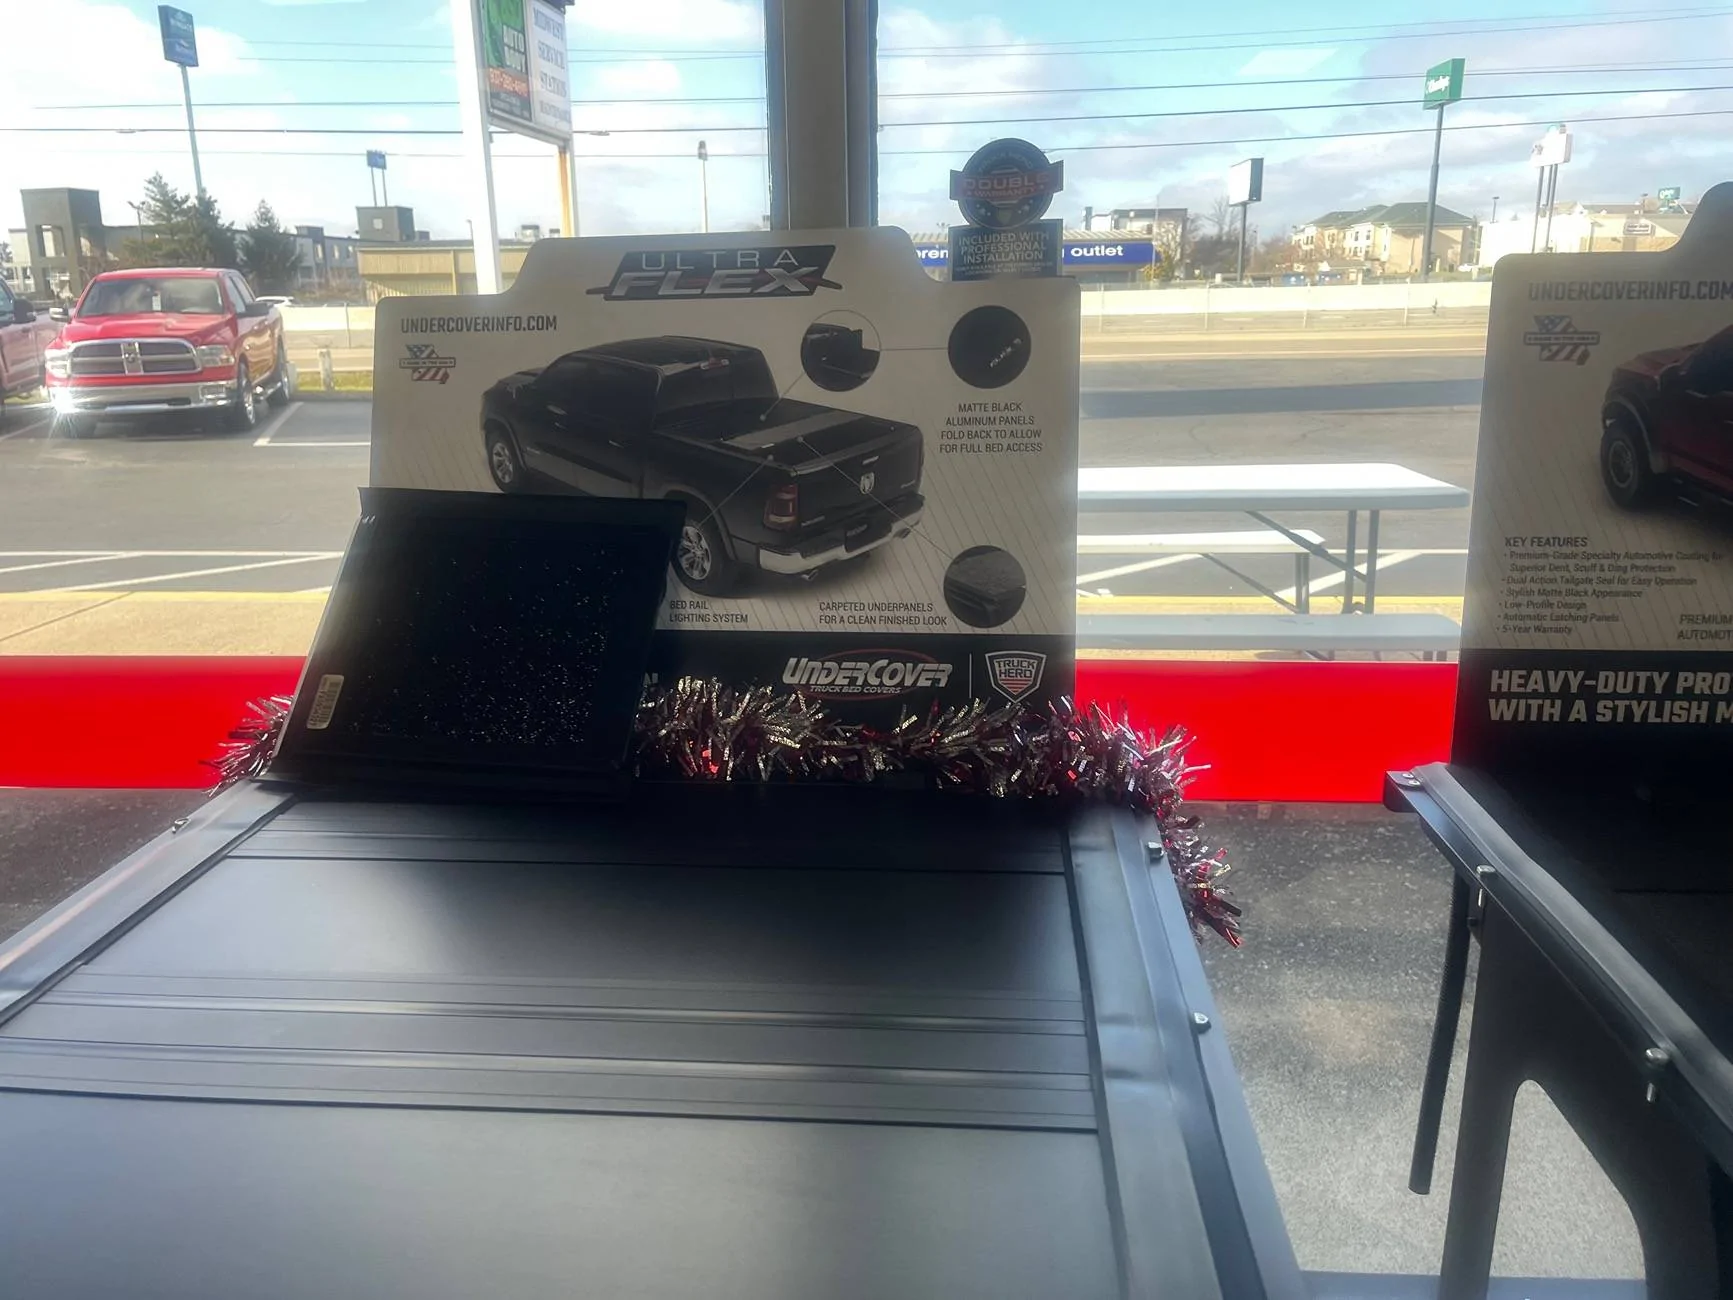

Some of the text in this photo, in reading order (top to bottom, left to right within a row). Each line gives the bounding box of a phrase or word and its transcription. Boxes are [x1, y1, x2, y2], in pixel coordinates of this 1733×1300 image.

[963, 172, 1050, 190] DOUBLE
[958, 230, 1050, 246] INCLUDED WITH
[960, 241, 1047, 256] PROFESSIONAL
[1070, 245, 1124, 257] outlet
[641, 250, 799, 270] ULTRA
[963, 250, 1044, 265] INSTALLATION
[611, 267, 819, 297] FLEX
[1528, 281, 1733, 301] UNDERCOVERINFO.COM
[401, 315, 558, 333] UNDERCOVERINFO.COM
[958, 402, 1022, 412] MATTE BLACK
[945, 416, 1035, 427] ALUMINUM PANELS
[941, 429, 1042, 440] FOLD BACK TO ALLOW
[939, 443, 1042, 454] FOR FULL BED ACCESS
[1504, 537, 1588, 547] KEY FEATURES
[1509, 551, 1579, 560] Premium-Grade
[1581, 551, 1621, 561] Specialty
[1623, 551, 1674, 560] Automotive
[1509, 563, 1676, 574] Superior Dent, Scuff & Ding Protection
[1507, 576, 1697, 587] Dual Action Tailgate Seal for Easy Operation
[1506, 588, 1643, 599] Stylish Matte Black Appearance
[669, 601, 709, 610] BED RAIL
[819, 602, 933, 612] CARPETED UNDERPANELS
[1504, 600, 1587, 611] Low-Profile Design
[669, 613, 748, 624] LIGHTING SYSTEM
[819, 615, 948, 626] FOR A CLEAN FINISHED LOOK
[1502, 613, 1620, 623] Automatic Latching Panels
[1679, 614, 1733, 625] PREMIUM
[1502, 625, 1573, 635] 5-Year Warranty
[1677, 629, 1733, 641] AUTOMOT
[994, 659, 1037, 670] TRUCK
[782, 656, 953, 688] UNDERCOVER
[999, 668, 1033, 680] HERO
[1490, 669, 1733, 695] HEAVY-DUTY PRO
[810, 684, 902, 694] TRUCK BED COVERS
[1488, 698, 1733, 724] WITH A STYLISH M
